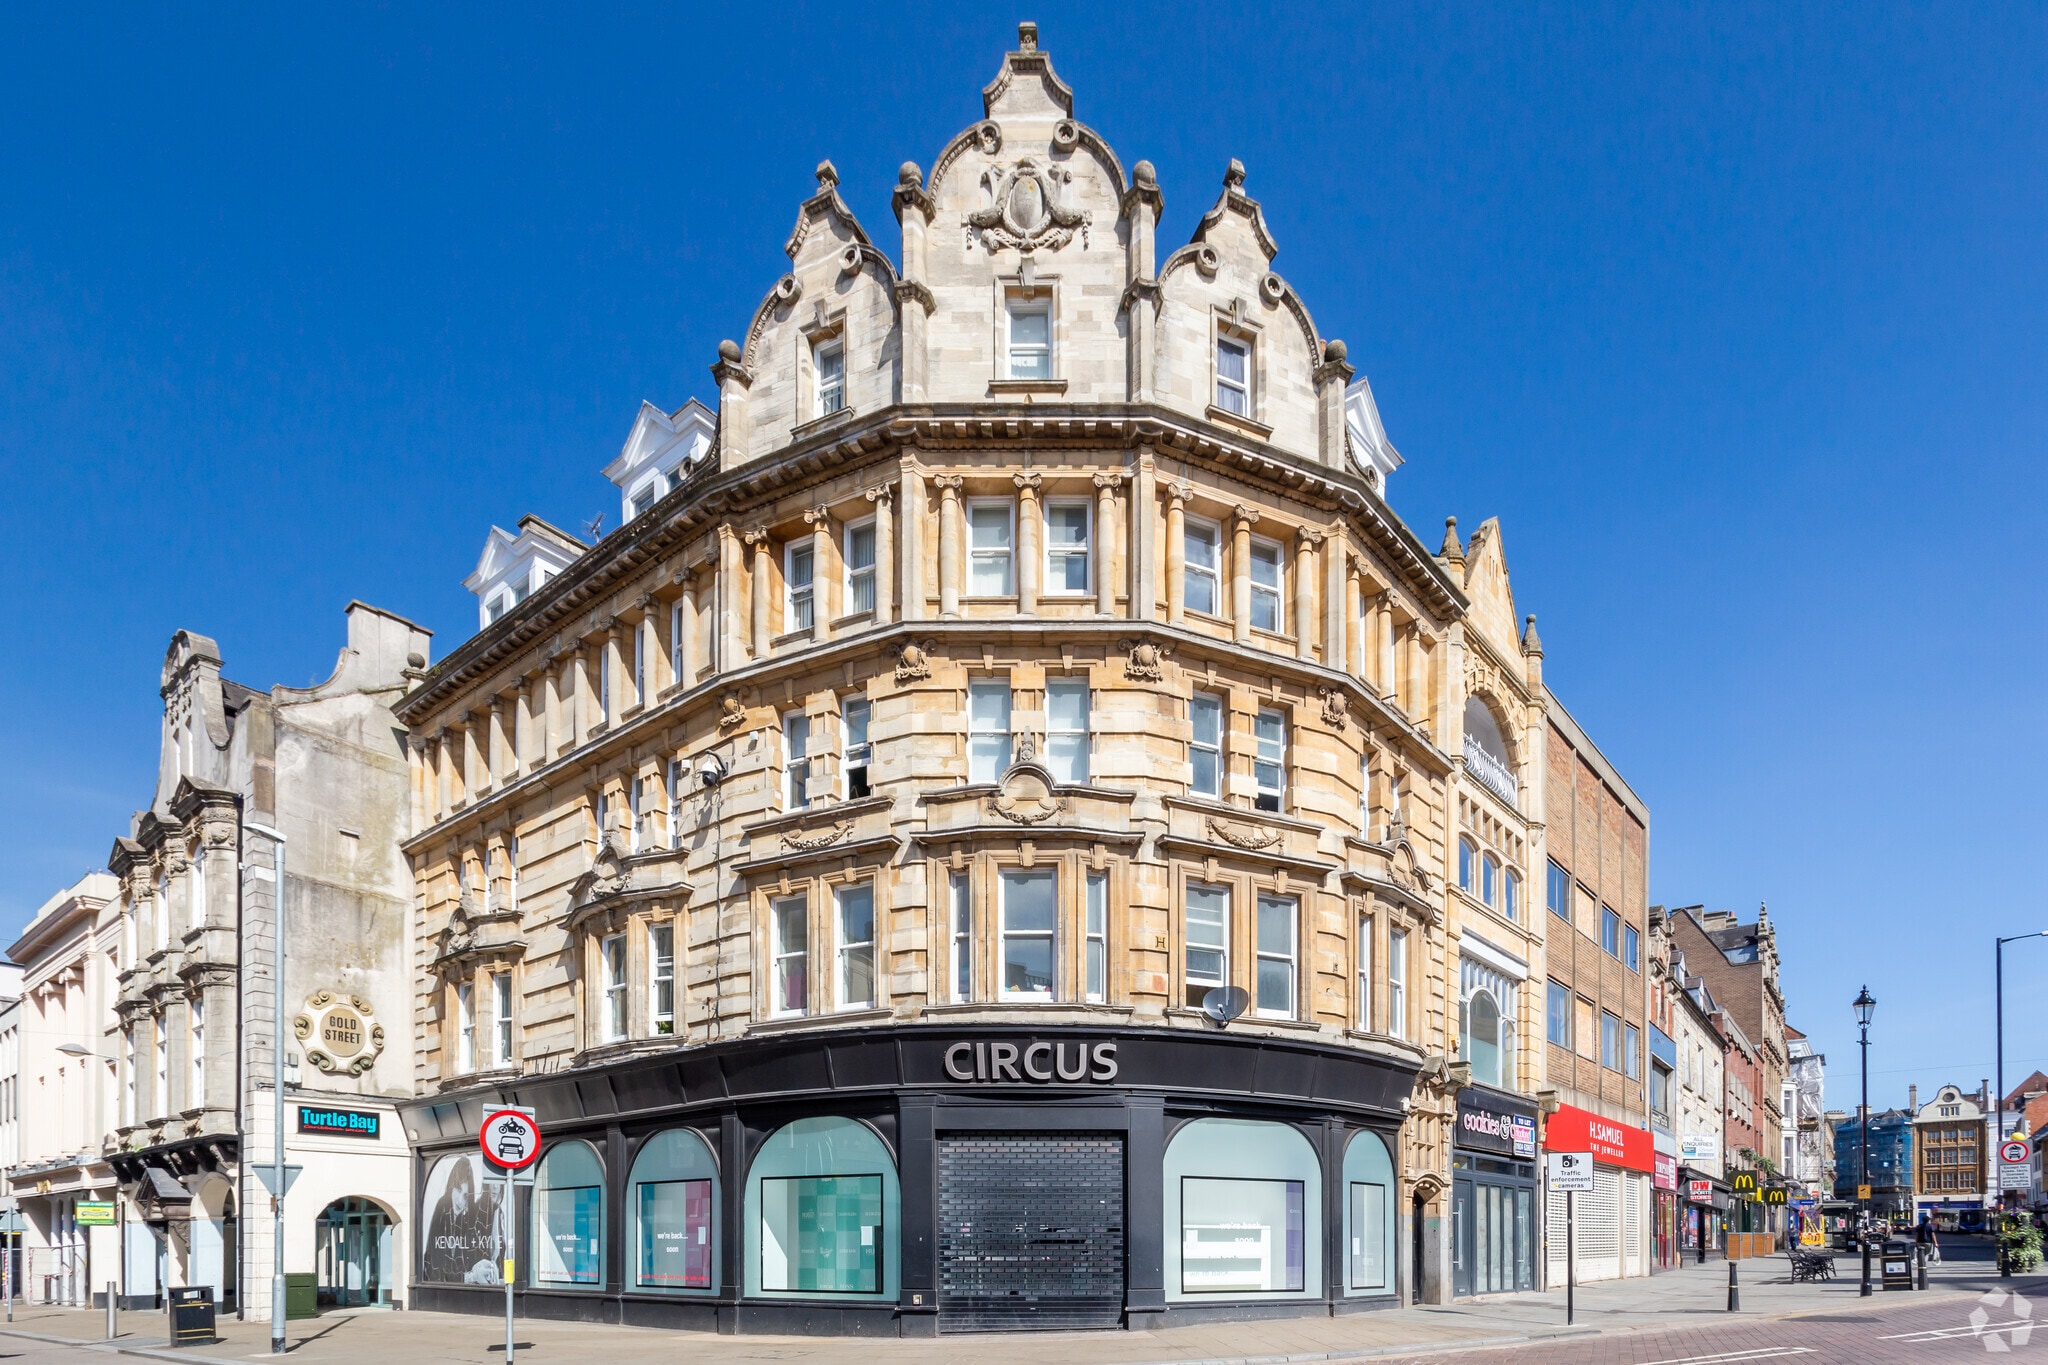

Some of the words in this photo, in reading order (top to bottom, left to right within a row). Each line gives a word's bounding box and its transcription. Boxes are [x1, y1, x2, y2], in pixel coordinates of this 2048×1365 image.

[329, 1016, 357, 1030] GOLD
[325, 1029, 361, 1044] STREET
[944, 1042, 1118, 1081] CIRCUS
[301, 1109, 347, 1127] Turtle
[349, 1113, 377, 1133] Bay
[1464, 1110, 1500, 1136] cookies
[1589, 1121, 1624, 1147] H.SAMUEL
[1590, 1143, 1600, 1152] THE
[1602, 1145, 1624, 1158] JEWELLER
[1691, 1181, 1709, 1190] DW
[435, 1235, 469, 1249] KENDALL
[478, 1235, 503, 1249] KYLE
